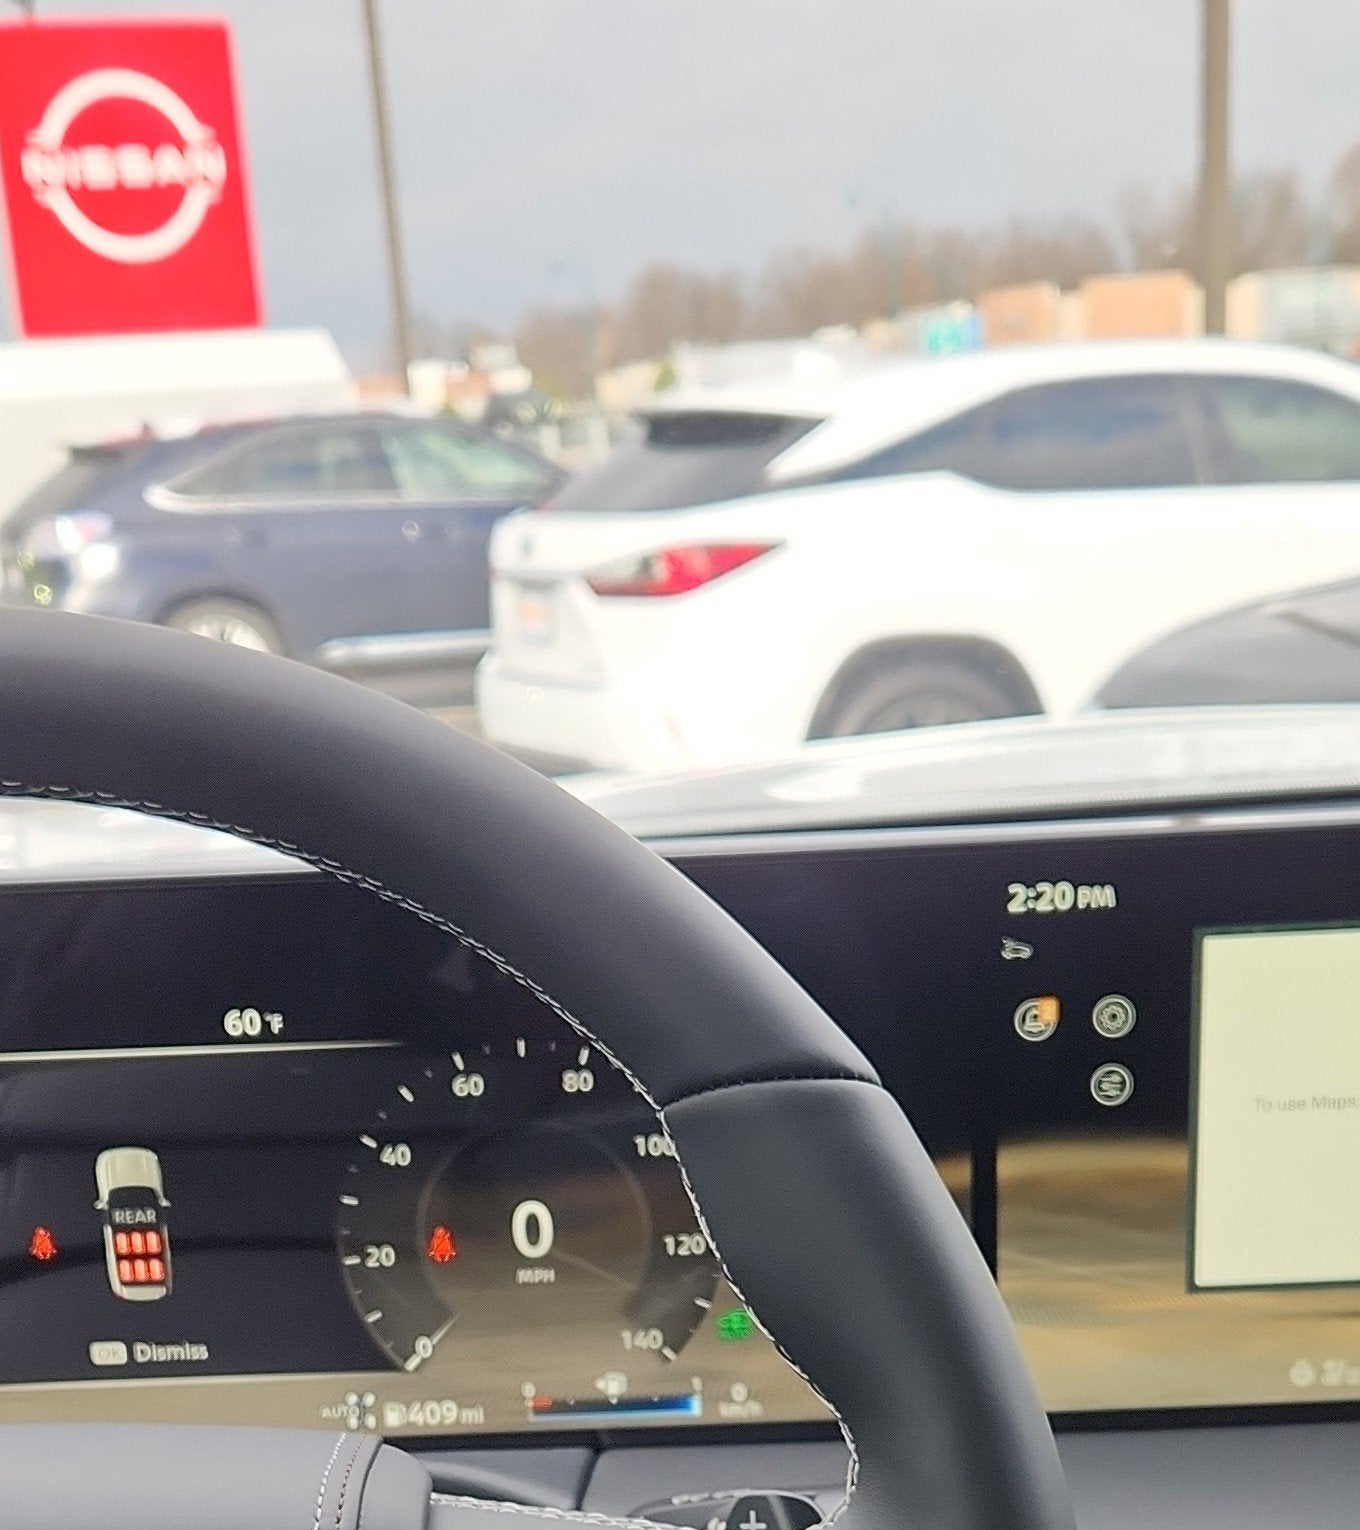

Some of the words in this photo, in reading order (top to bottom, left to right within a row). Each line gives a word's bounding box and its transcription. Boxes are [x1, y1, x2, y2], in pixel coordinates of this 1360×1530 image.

[451, 1072, 485, 1097] 60
[561, 1068, 594, 1093] 80
[1253, 1096, 1274, 1113] To
[1277, 1098, 1307, 1113] use
[1311, 1094, 1360, 1112] Maps,
[379, 1143, 412, 1167] 40
[633, 1132, 677, 1157] 100
[114, 1208, 157, 1225] REAR
[511, 1200, 555, 1259] 0
[365, 1244, 396, 1268] 20
[663, 1234, 707, 1257] 120
[515, 1268, 556, 1285] MPH
[415, 1335, 434, 1360] 0
[621, 1328, 664, 1352] 140
[133, 1341, 209, 1364] Dismiss
[407, 1399, 459, 1426] 409
